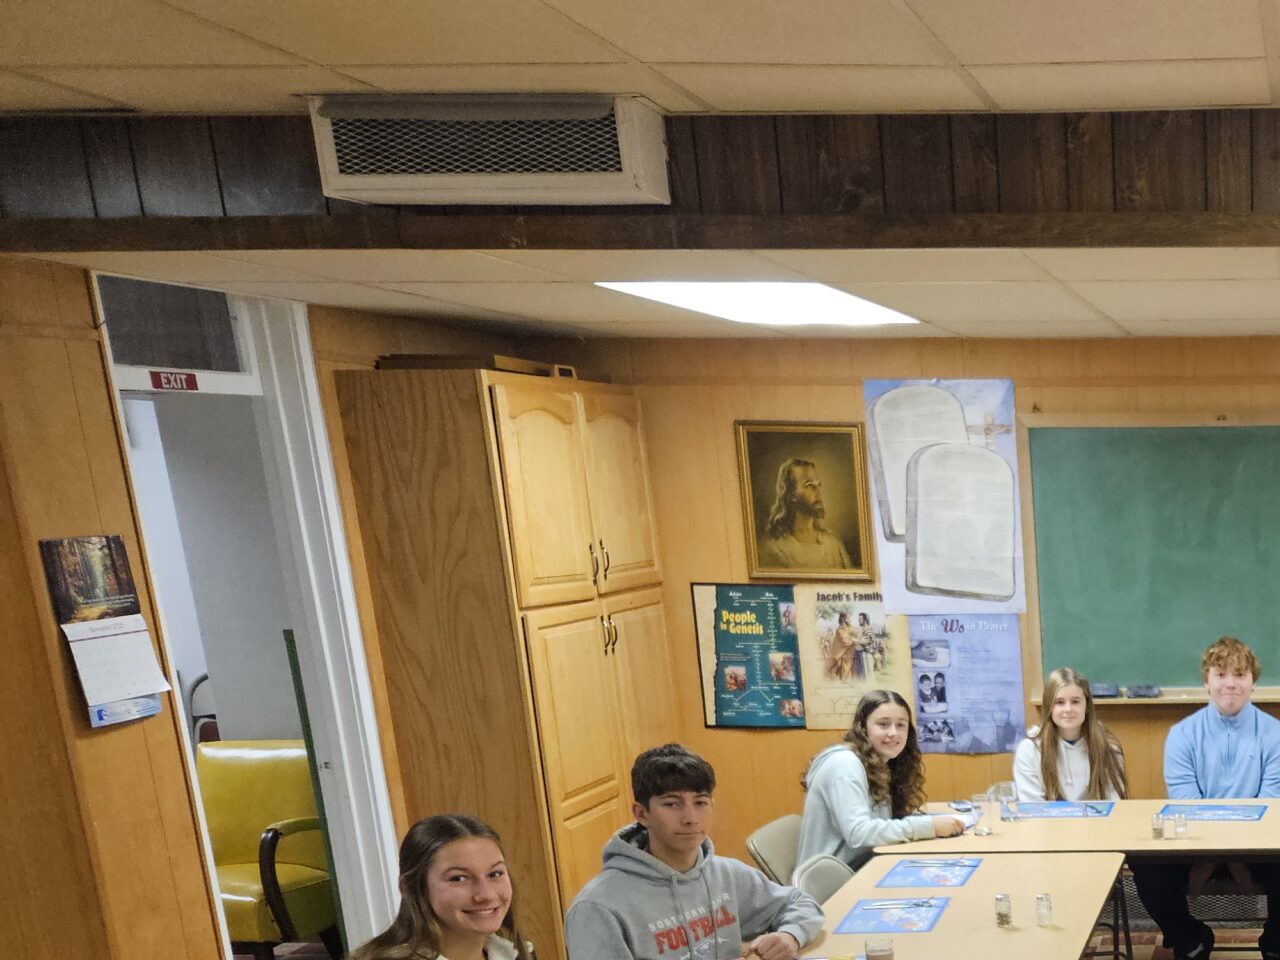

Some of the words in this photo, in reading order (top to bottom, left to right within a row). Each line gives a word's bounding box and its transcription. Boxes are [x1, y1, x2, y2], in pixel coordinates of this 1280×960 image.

[160, 373, 188, 389] EXIT
[816, 592, 852, 603] Jacob's
[722, 610, 757, 624] People
[720, 622, 728, 631] in
[729, 622, 763, 635] Genesis
[919, 620, 938, 631] The
[941, 618, 965, 633] Ws
[967, 620, 977, 631] of
[979, 620, 1009, 632] Prayer
